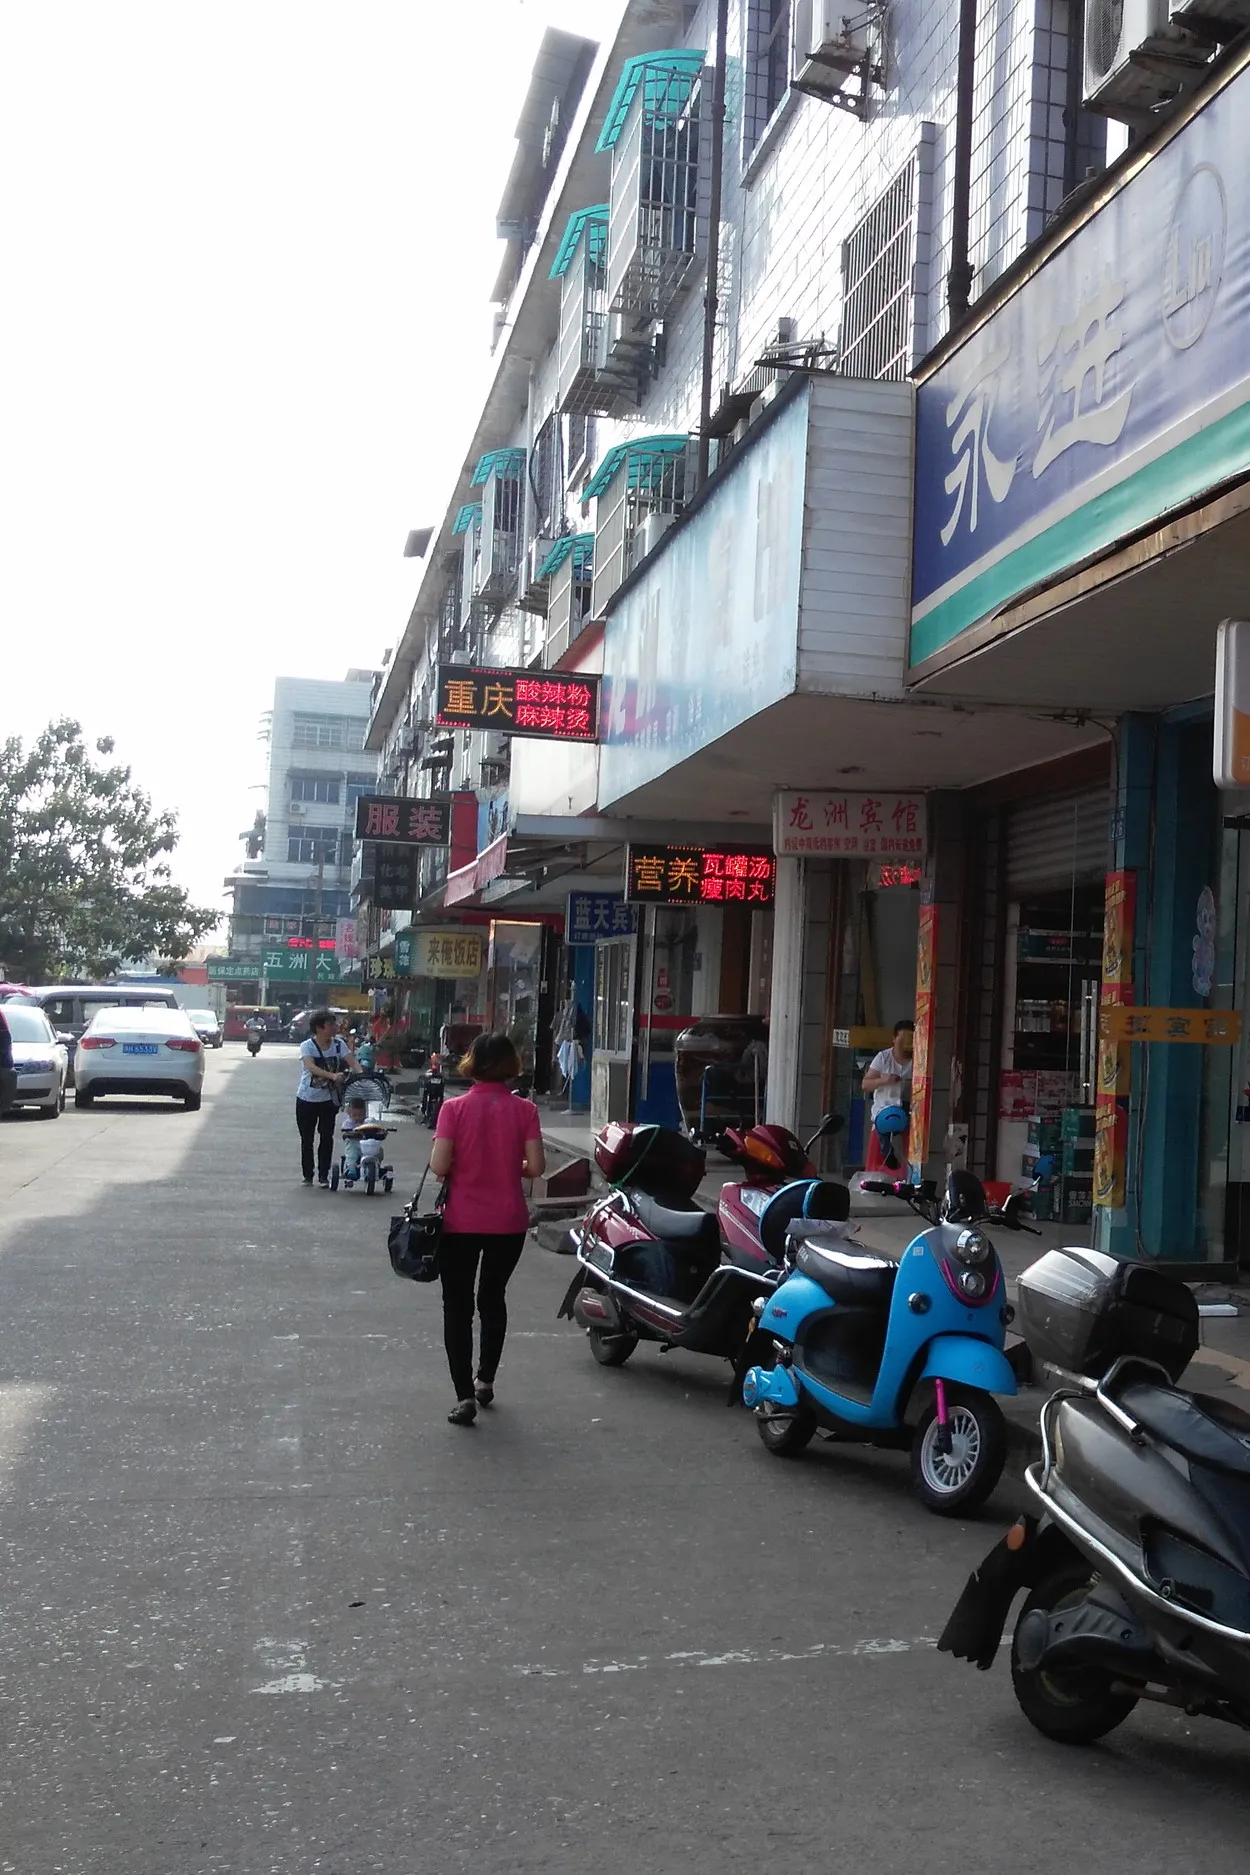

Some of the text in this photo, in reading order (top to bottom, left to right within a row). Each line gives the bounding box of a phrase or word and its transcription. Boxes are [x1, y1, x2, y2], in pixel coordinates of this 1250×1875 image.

[443, 680, 514, 718] 重庆
[515, 679, 592, 706] 酸辣粉
[515, 704, 590, 731] 麻辣烫
[365, 803, 443, 840] 服装
[788, 796, 921, 833] 龙洲宾馆
[633, 856, 699, 894] 营养
[701, 852, 771, 879] 瓦罐汤
[700, 877, 769, 902] 瘦肉丸
